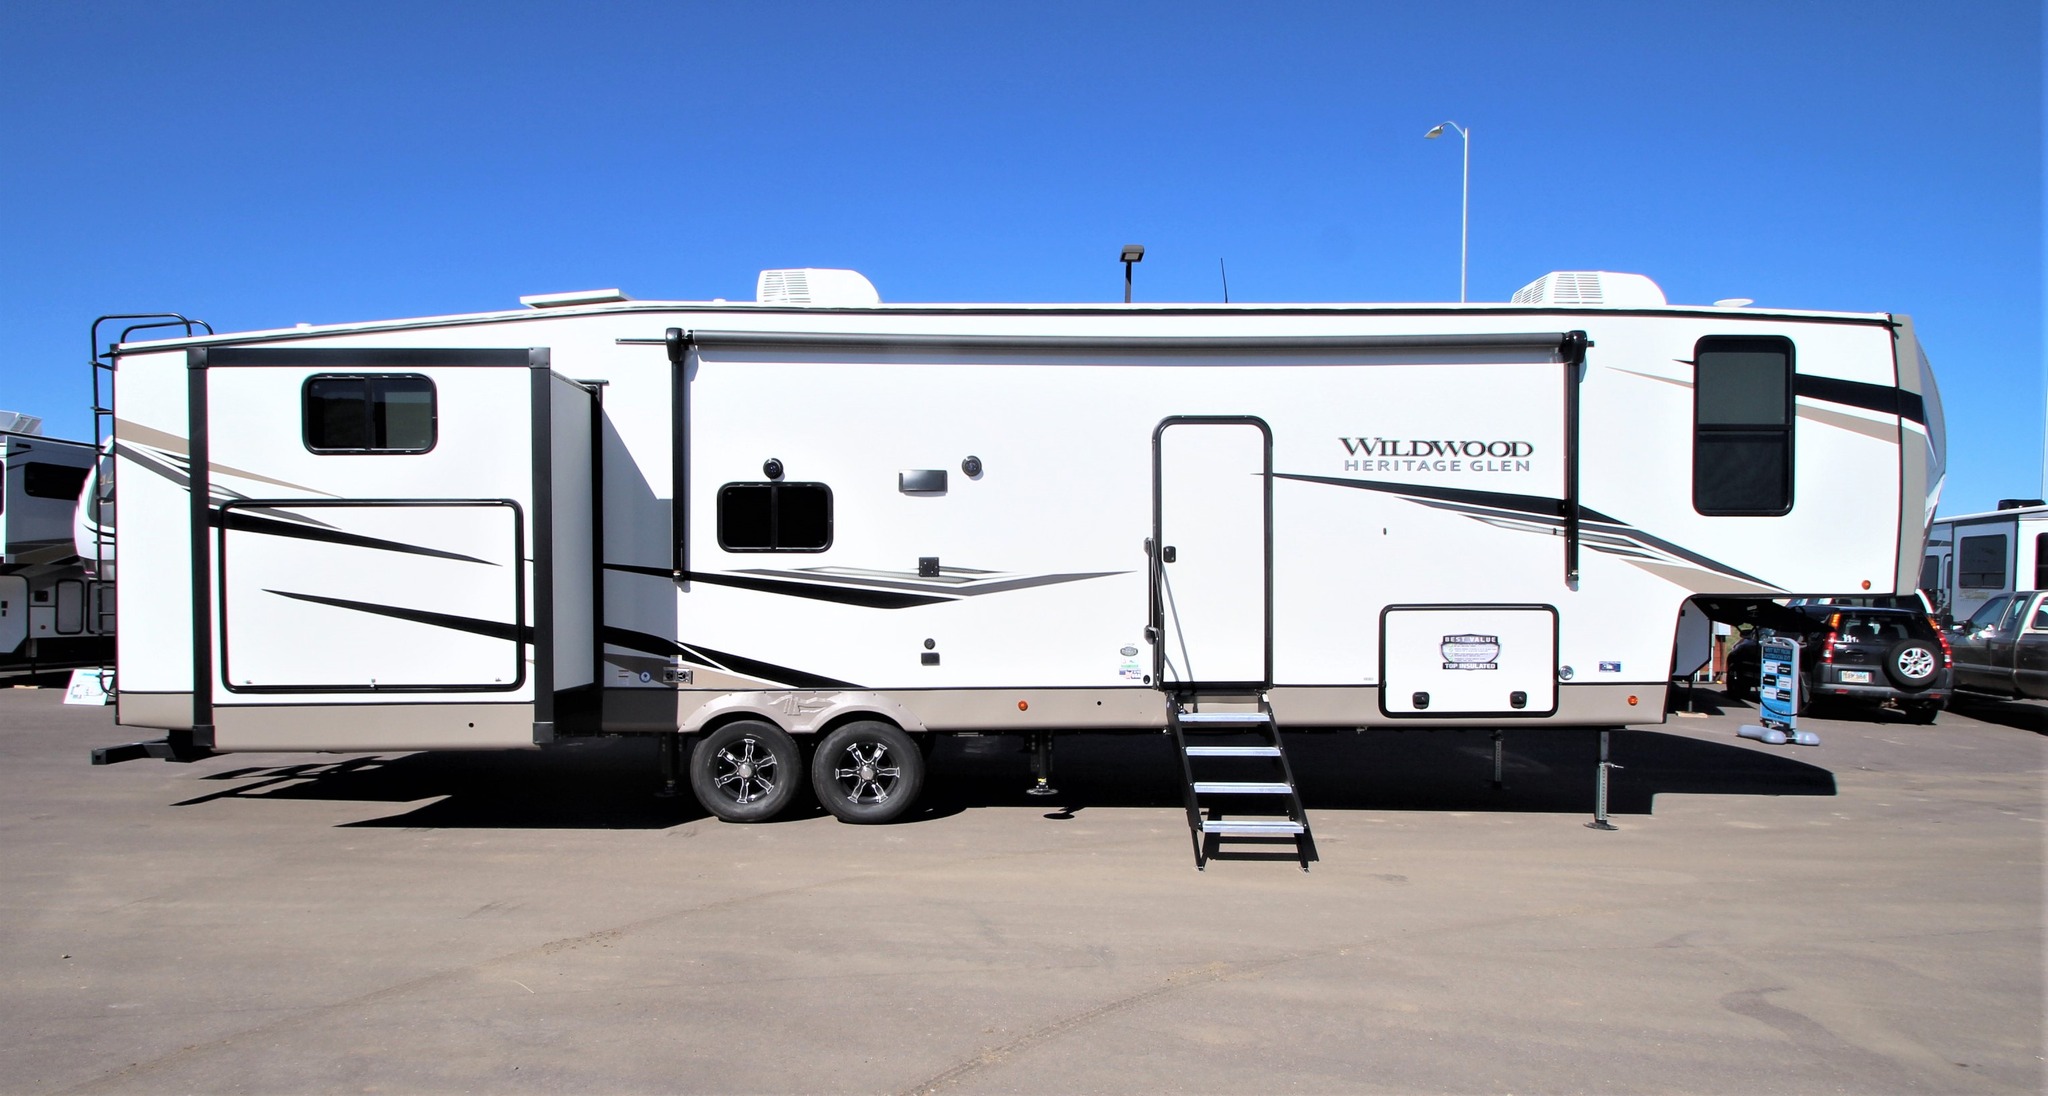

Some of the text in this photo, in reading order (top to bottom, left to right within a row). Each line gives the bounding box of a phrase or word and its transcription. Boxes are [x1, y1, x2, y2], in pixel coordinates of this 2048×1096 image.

[1338, 437, 1534, 458] WILDWOOD
[1344, 459, 1530, 472] HERITAGE GLEN
